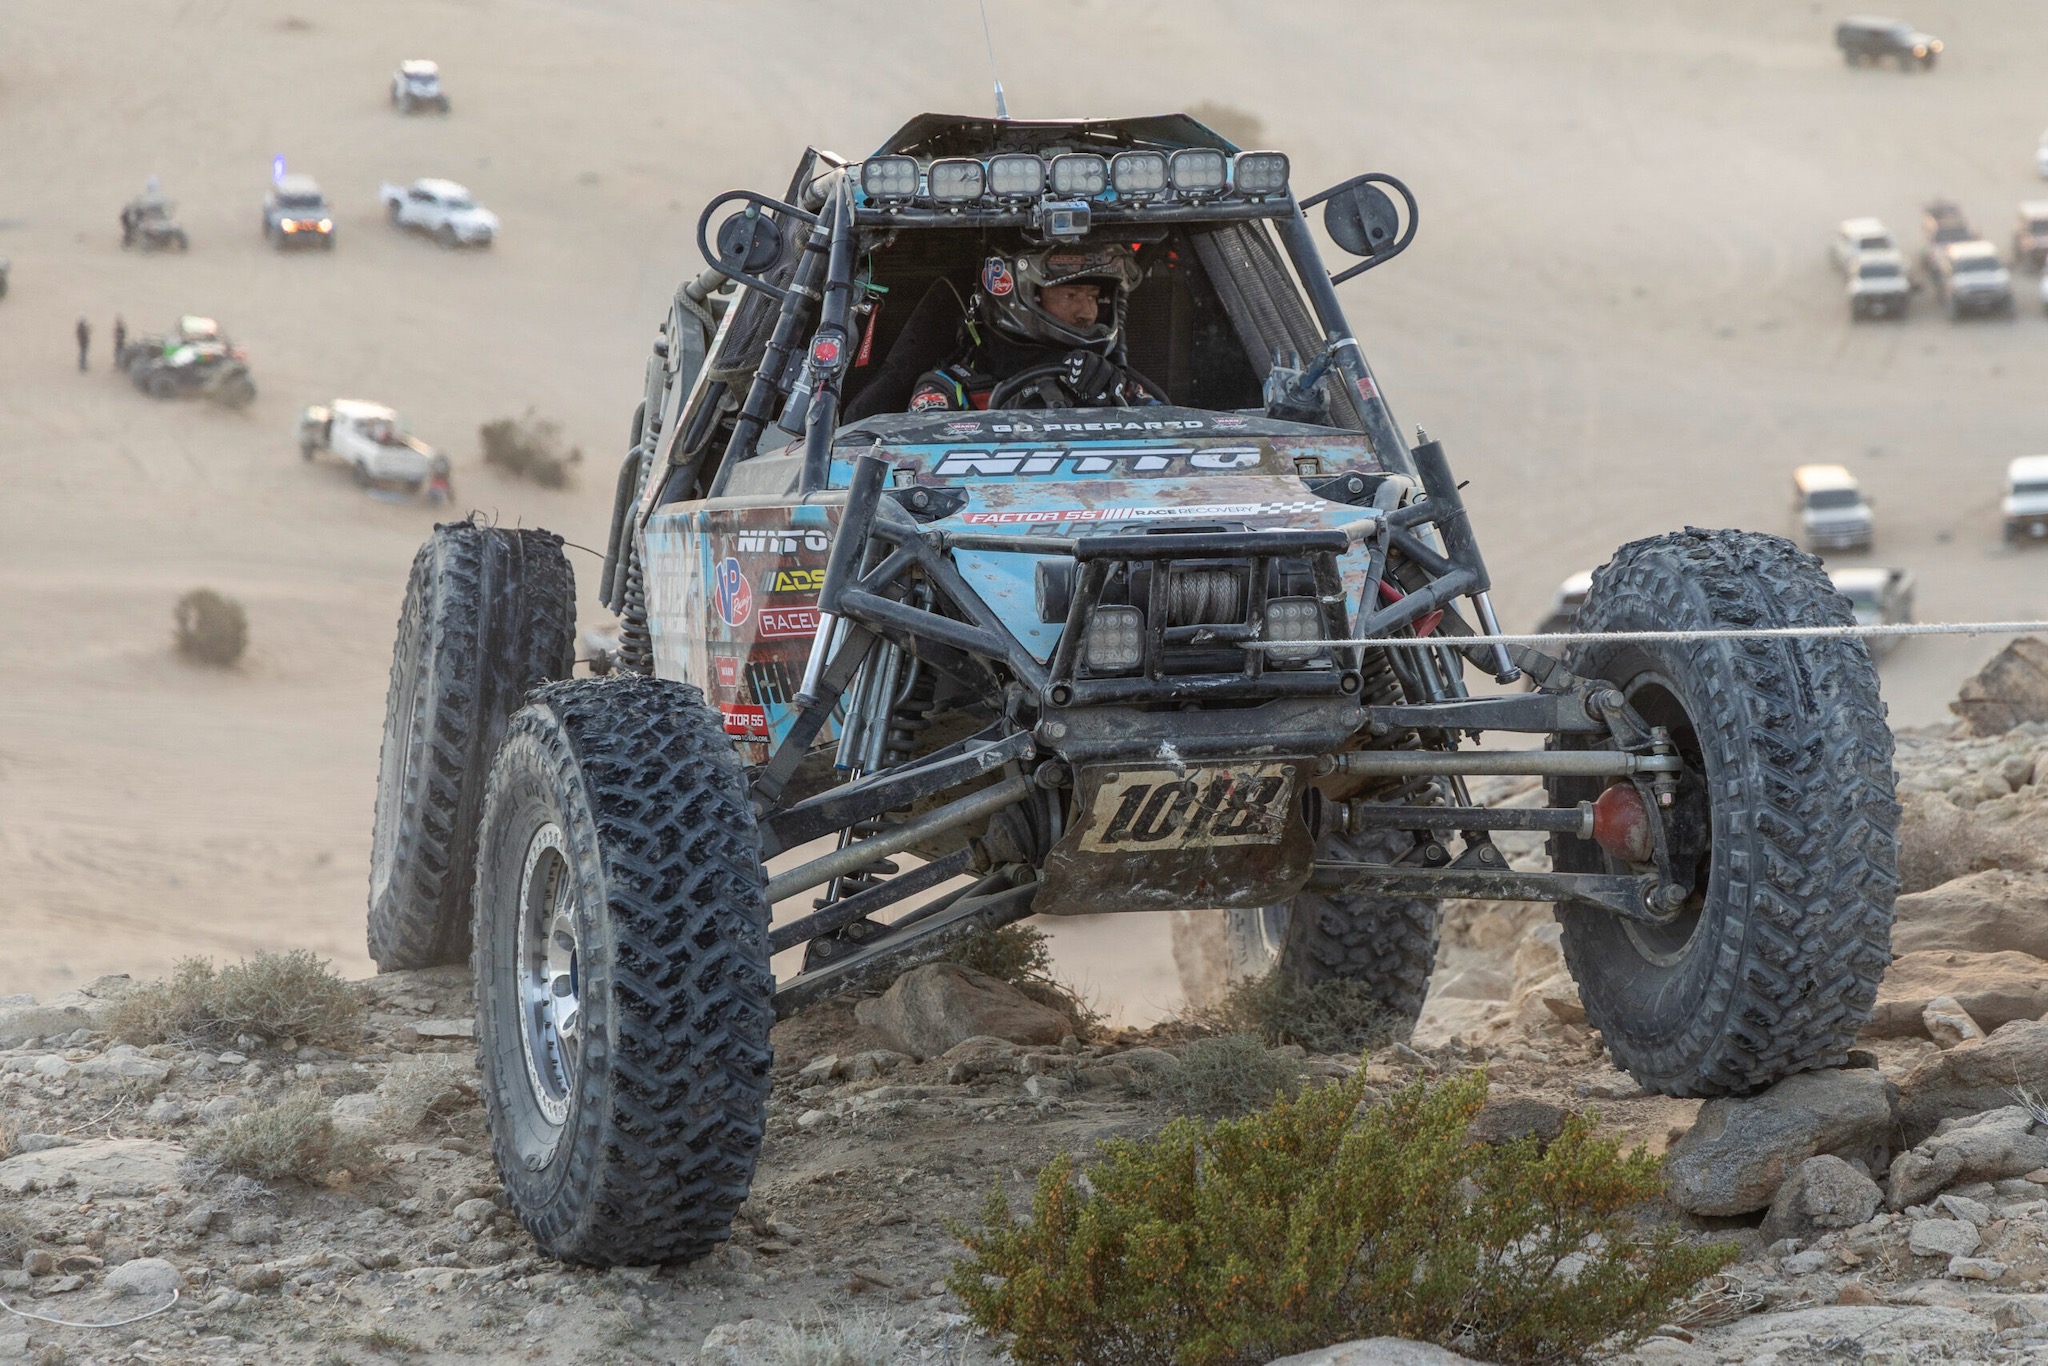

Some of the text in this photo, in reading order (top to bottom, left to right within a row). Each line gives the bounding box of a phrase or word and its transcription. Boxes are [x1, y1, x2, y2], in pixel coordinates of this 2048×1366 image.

[1042, 420, 1204, 433] PREPARED
[932, 446, 1262, 476] NITTO
[970, 510, 1097, 523] FACTOR 55
[1178, 505, 1253, 514] RECOVERY
[737, 529, 828, 553] NITTO
[774, 569, 826, 592] ADS
[715, 557, 741, 624] VP
[720, 666, 734, 677] WARN
[721, 711, 765, 727] ACTOR 55
[1098, 776, 1285, 845] 1018
